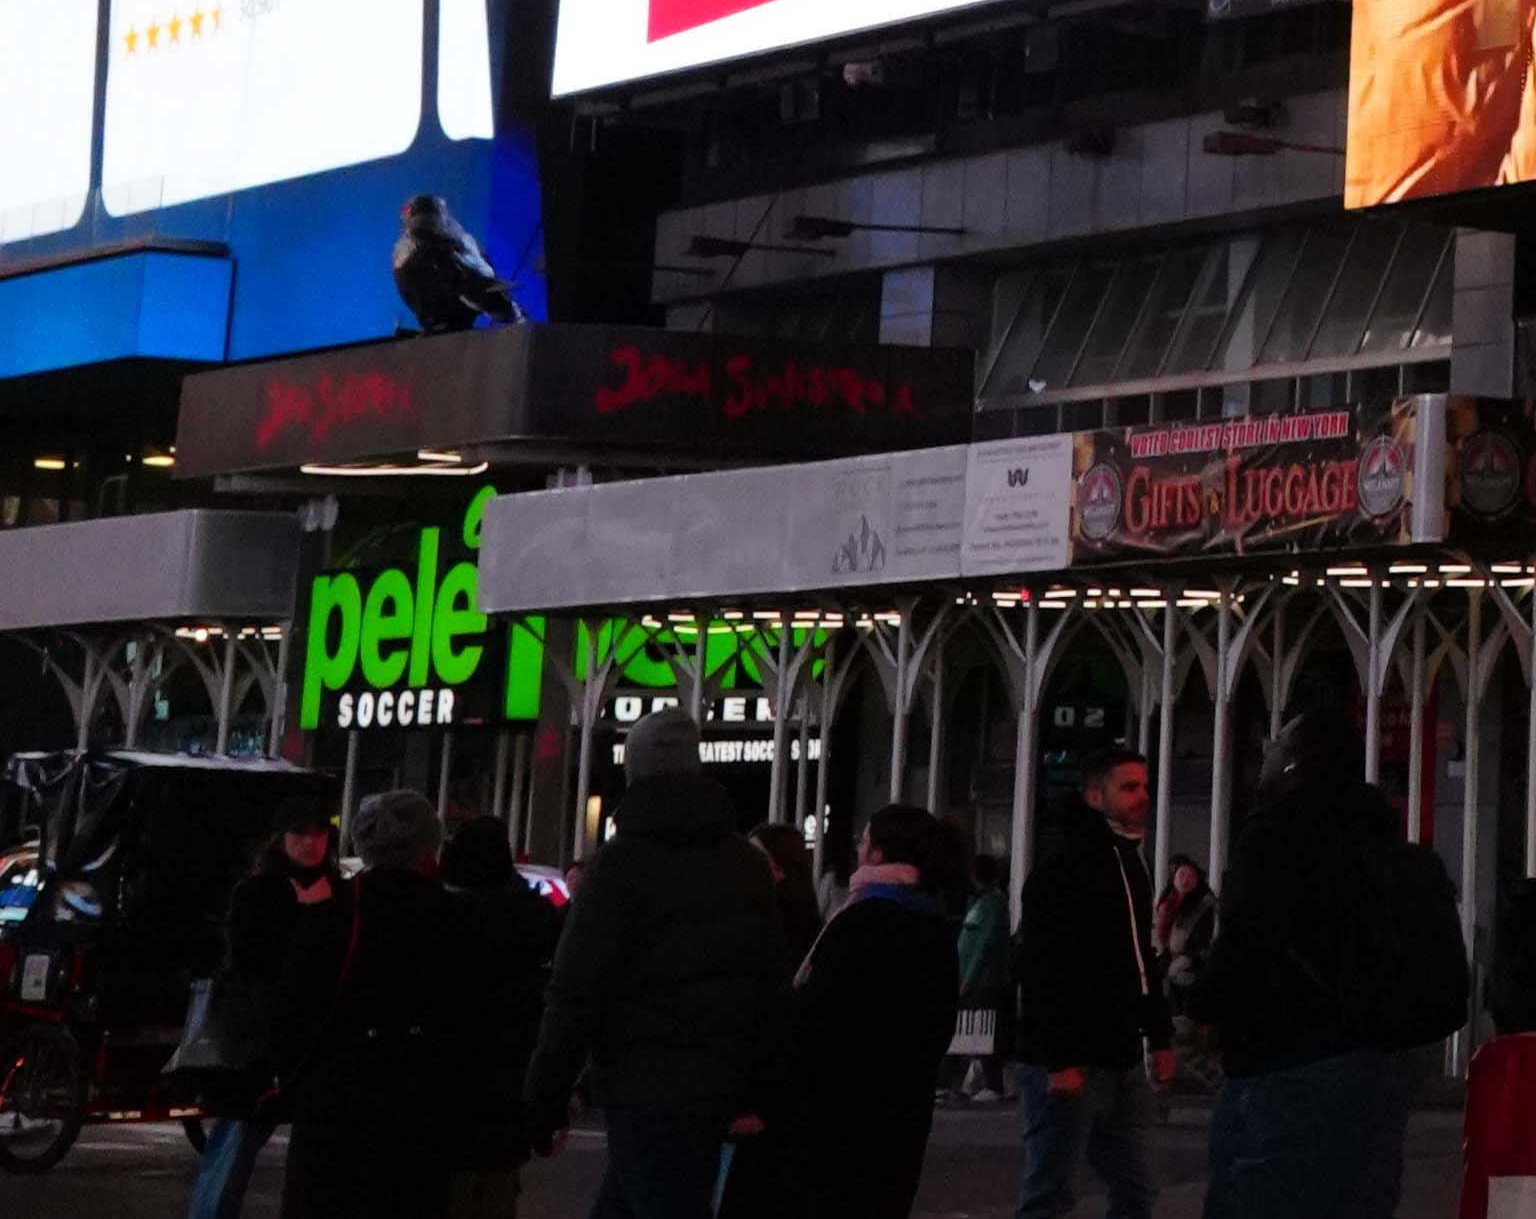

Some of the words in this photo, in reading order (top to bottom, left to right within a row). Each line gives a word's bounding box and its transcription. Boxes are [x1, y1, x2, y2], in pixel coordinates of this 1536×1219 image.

[1125, 466, 1201, 533] GIFTS
[1223, 453, 1361, 531] LUGGAGE
[337, 688, 455, 728] SOCCER
